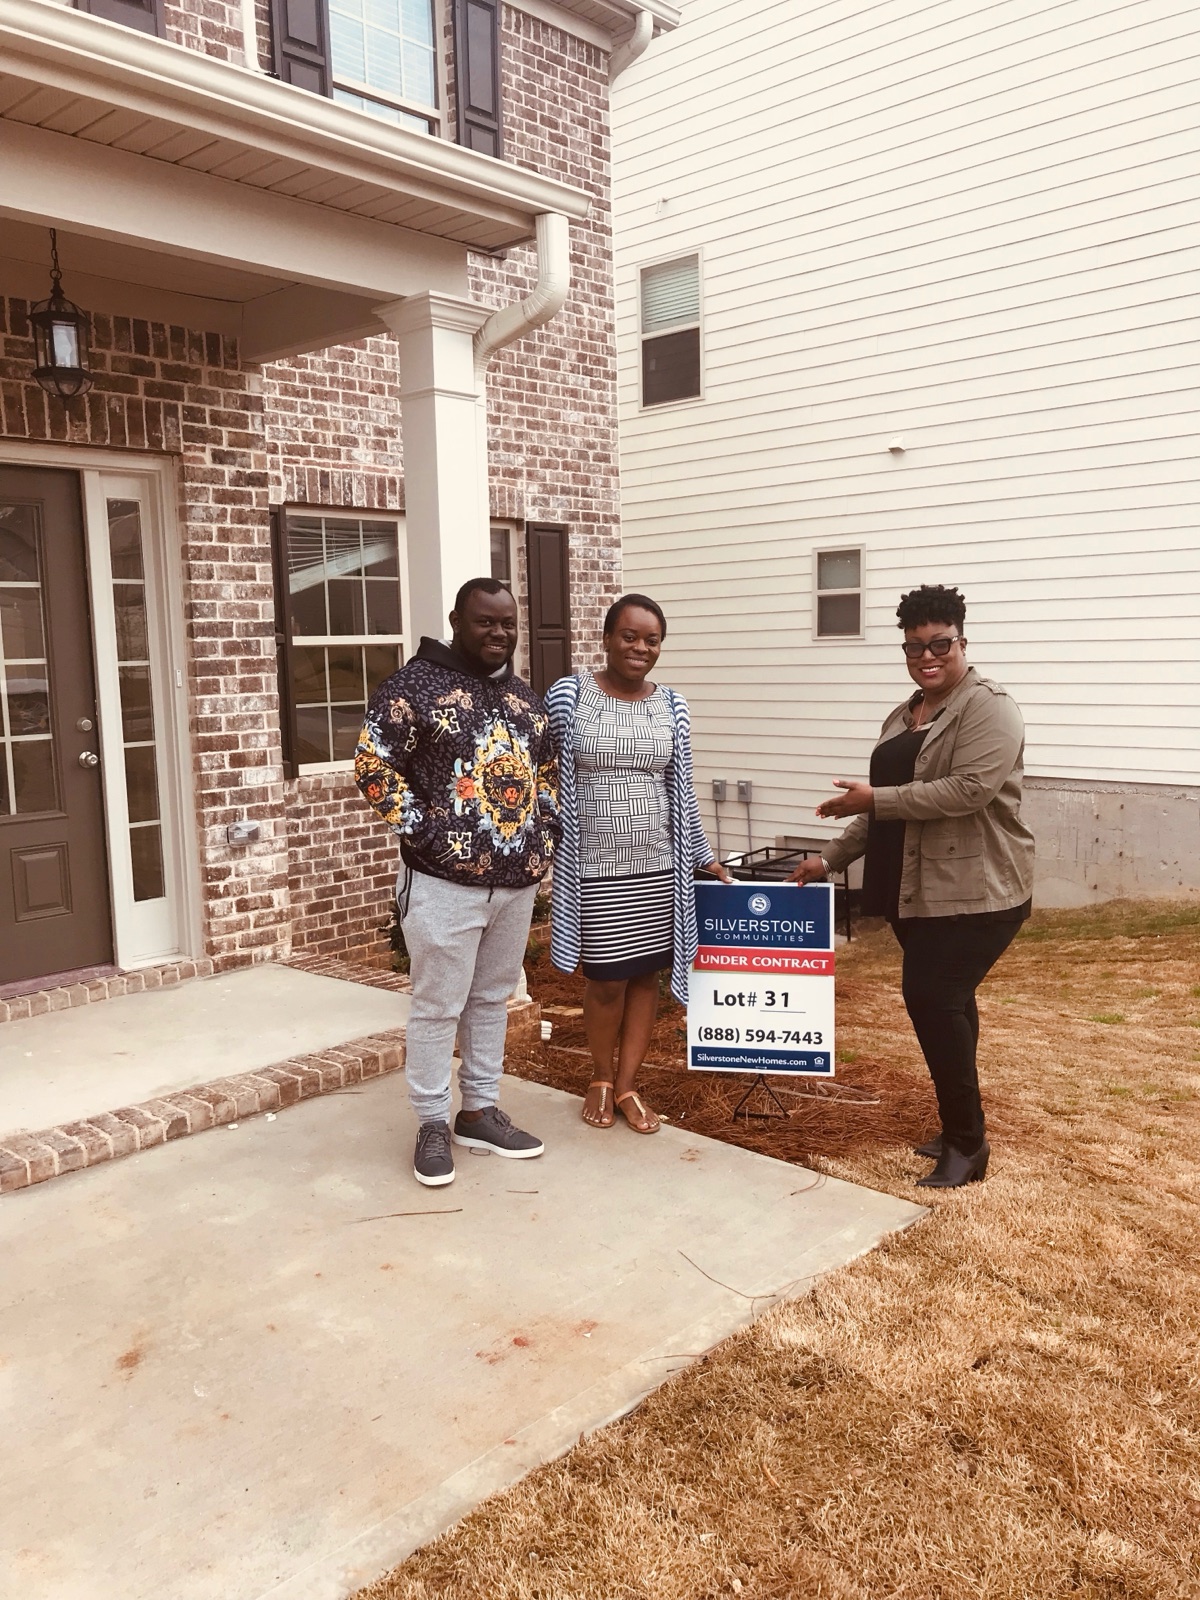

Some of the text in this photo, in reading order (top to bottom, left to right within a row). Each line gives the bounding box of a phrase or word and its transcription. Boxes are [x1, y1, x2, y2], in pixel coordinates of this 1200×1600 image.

[704, 918, 815, 933] SILVERSTONE
[715, 933, 804, 942] COMMUNITIES
[700, 954, 829, 969] UNDER CONTRACT
[713, 989, 789, 1008] Lot# 31
[698, 1026, 823, 1045] (888) 594-7443
[697, 1053, 807, 1066] SilverstoneNewHomes.com
